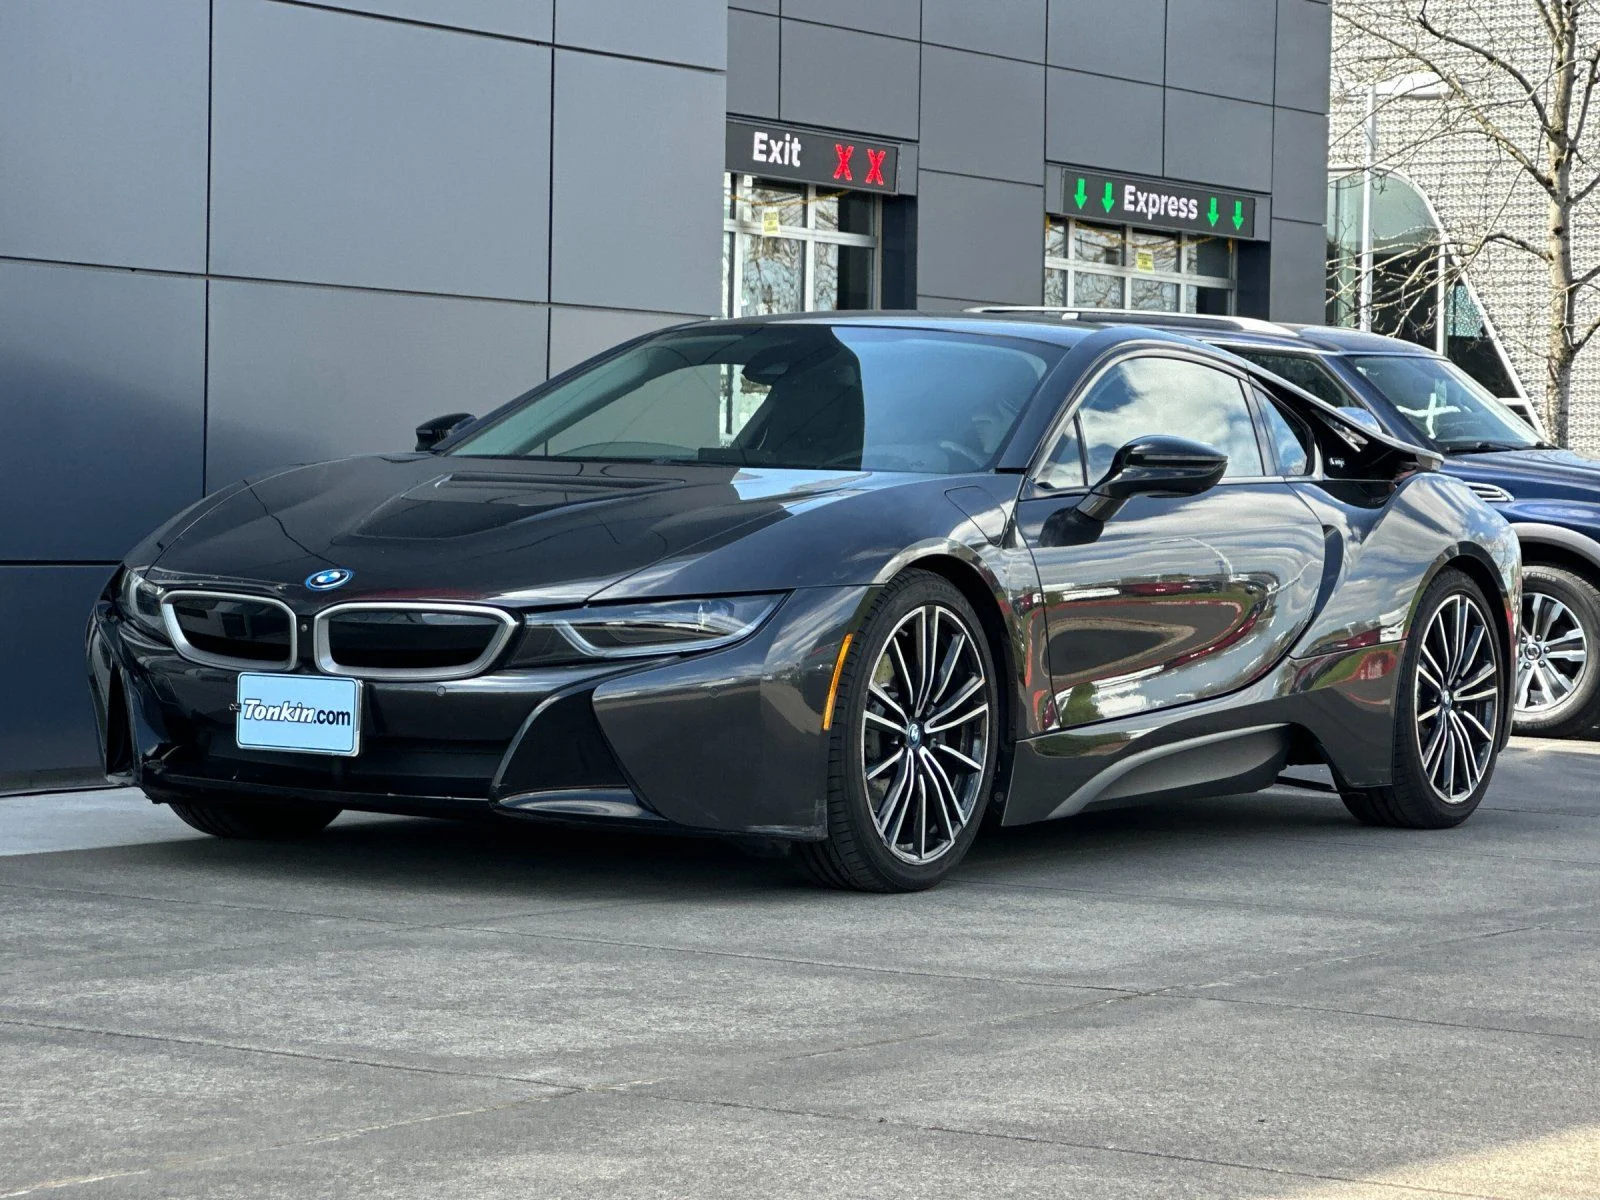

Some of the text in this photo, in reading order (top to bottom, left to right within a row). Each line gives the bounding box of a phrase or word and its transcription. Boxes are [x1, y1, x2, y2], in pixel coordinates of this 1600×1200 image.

[753, 131, 802, 168] Exit
[1123, 184, 1199, 220] Express
[243, 698, 351, 726] Tonkin.com
